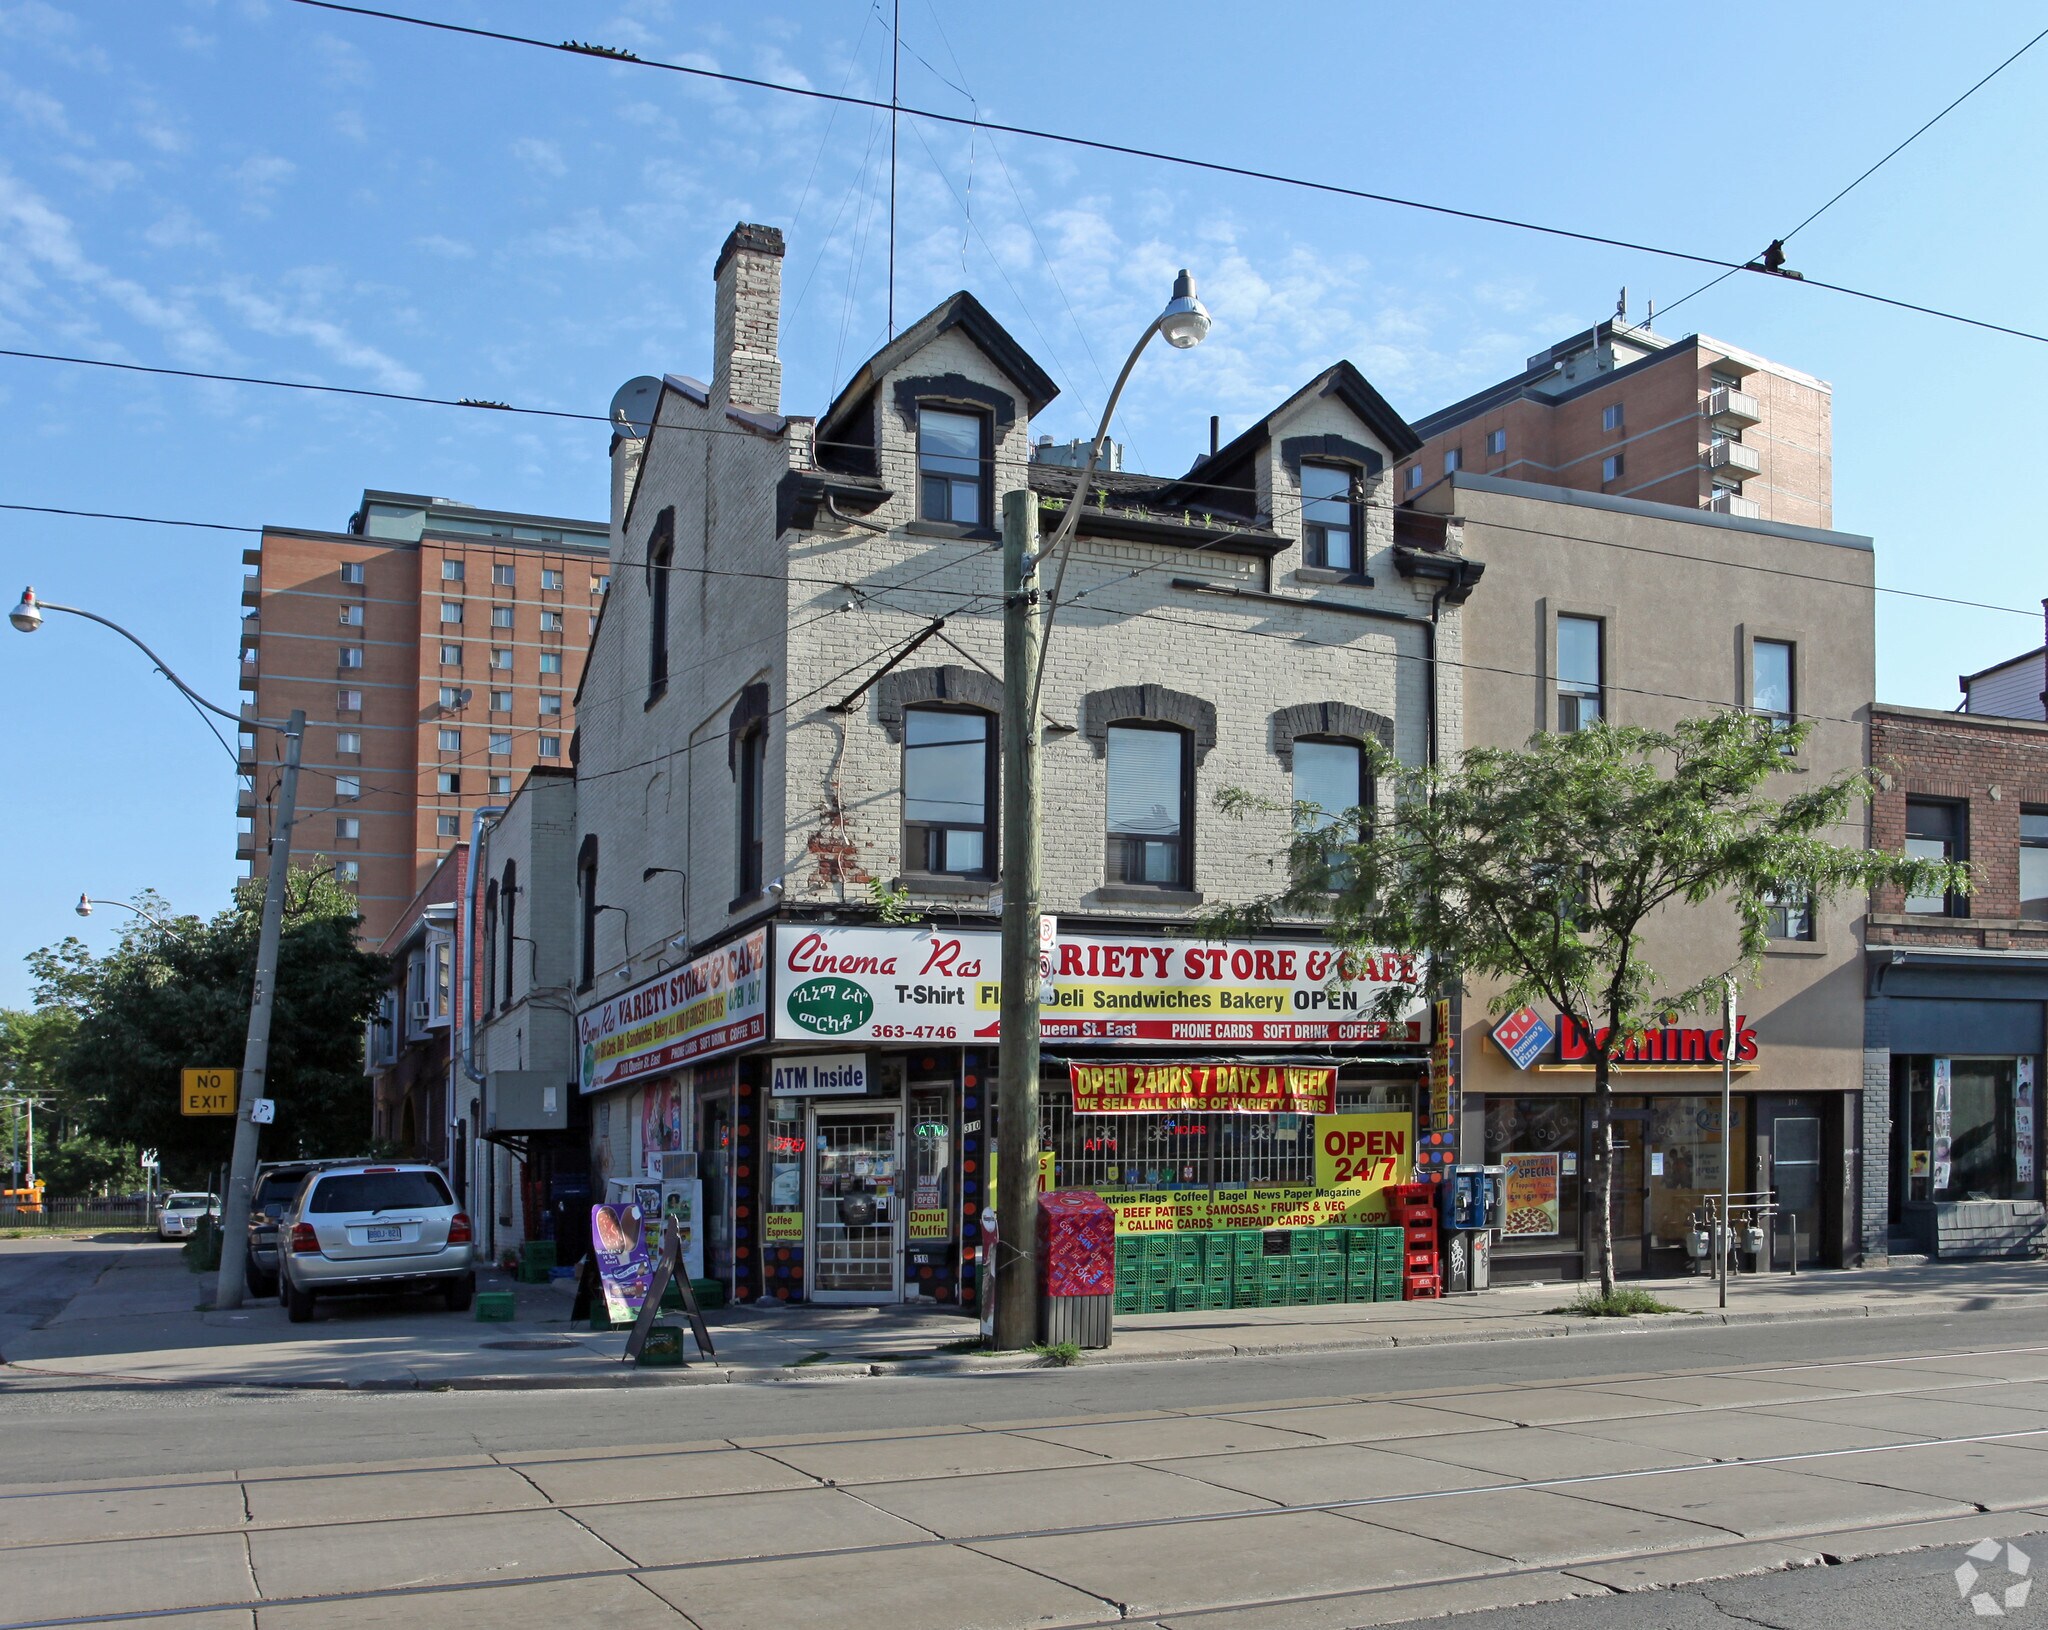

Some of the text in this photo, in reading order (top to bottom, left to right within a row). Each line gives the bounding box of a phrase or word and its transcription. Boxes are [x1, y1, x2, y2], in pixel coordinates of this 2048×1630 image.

[787, 933, 982, 978] Cinema Ras
[1183, 948, 1297, 981] STORE
[1306, 950, 1332, 981] &
[619, 981, 668, 1026] VARIETY
[670, 961, 709, 1007] STORE
[710, 955, 725, 989] &
[728, 984, 745, 1011] OPEN
[895, 985, 965, 1005] T-Shirt
[1093, 988, 1212, 1010] Sandwiches
[1220, 991, 1284, 1014] Bakery
[1294, 990, 1357, 1010] OPEN
[626, 1024, 653, 1049] Sandwiches
[871, 1024, 957, 1039] 363-4746
[1040, 1022, 1078, 1036] ueen
[1082, 1021, 1102, 1036] St.
[1105, 1022, 1137, 1037] East
[1171, 1023, 1211, 1038] PHONE
[1214, 1024, 1254, 1039] CARDS
[1262, 1023, 1291, 1039] SOFT
[1294, 1024, 1329, 1039] DRINK
[1338, 1023, 1380, 1039] COFFEE
[650, 1053, 661, 1067] East
[700, 1034, 712, 1050] SOFT
[712, 1029, 727, 1047] DRINK
[730, 1026, 748, 1043] COFFEE
[751, 1019, 761, 1035] TEA
[1510, 1024, 1544, 1057] Domino's
[1517, 1043, 1538, 1066] Pizza
[197, 1075, 221, 1089] NO
[774, 1064, 864, 1090] ATM Inside
[1078, 1066, 1329, 1096] OPEN 24HRS 7 DAYS A WEEK
[190, 1095, 228, 1109] EXIT
[1077, 1096, 1327, 1112] WE SELL ALL KINDS OF VARIETY ITEMS
[964, 1120, 981, 1133] 310
[1174, 1125, 1206, 1135] HOURS
[1085, 1138, 1117, 1151] ATM
[1324, 1130, 1405, 1156] OPEN
[1335, 1156, 1396, 1182] 24/7
[1519, 1158, 1538, 1167] CARRY
[919, 1175, 937, 1187] SUN
[1518, 1167, 1556, 1179] SPECIAL
[917, 1196, 937, 1204] OPEN
[1102, 1187, 1361, 1205] untries Flags Coffee Bagel News Paper Magazine
[909, 1211, 945, 1223] Donut
[1123, 1200, 1346, 1218] BEEF PATIES SAMOSAS FRUITS & VEG
[767, 1215, 793, 1225] Coffee
[1127, 1212, 1388, 1231] CALLING CARDS PREPAID CARDS FAX COPY
[767, 1227, 802, 1241] Espresso
[909, 1225, 947, 1237] Muffin
[914, 1255, 928, 1263] 310
